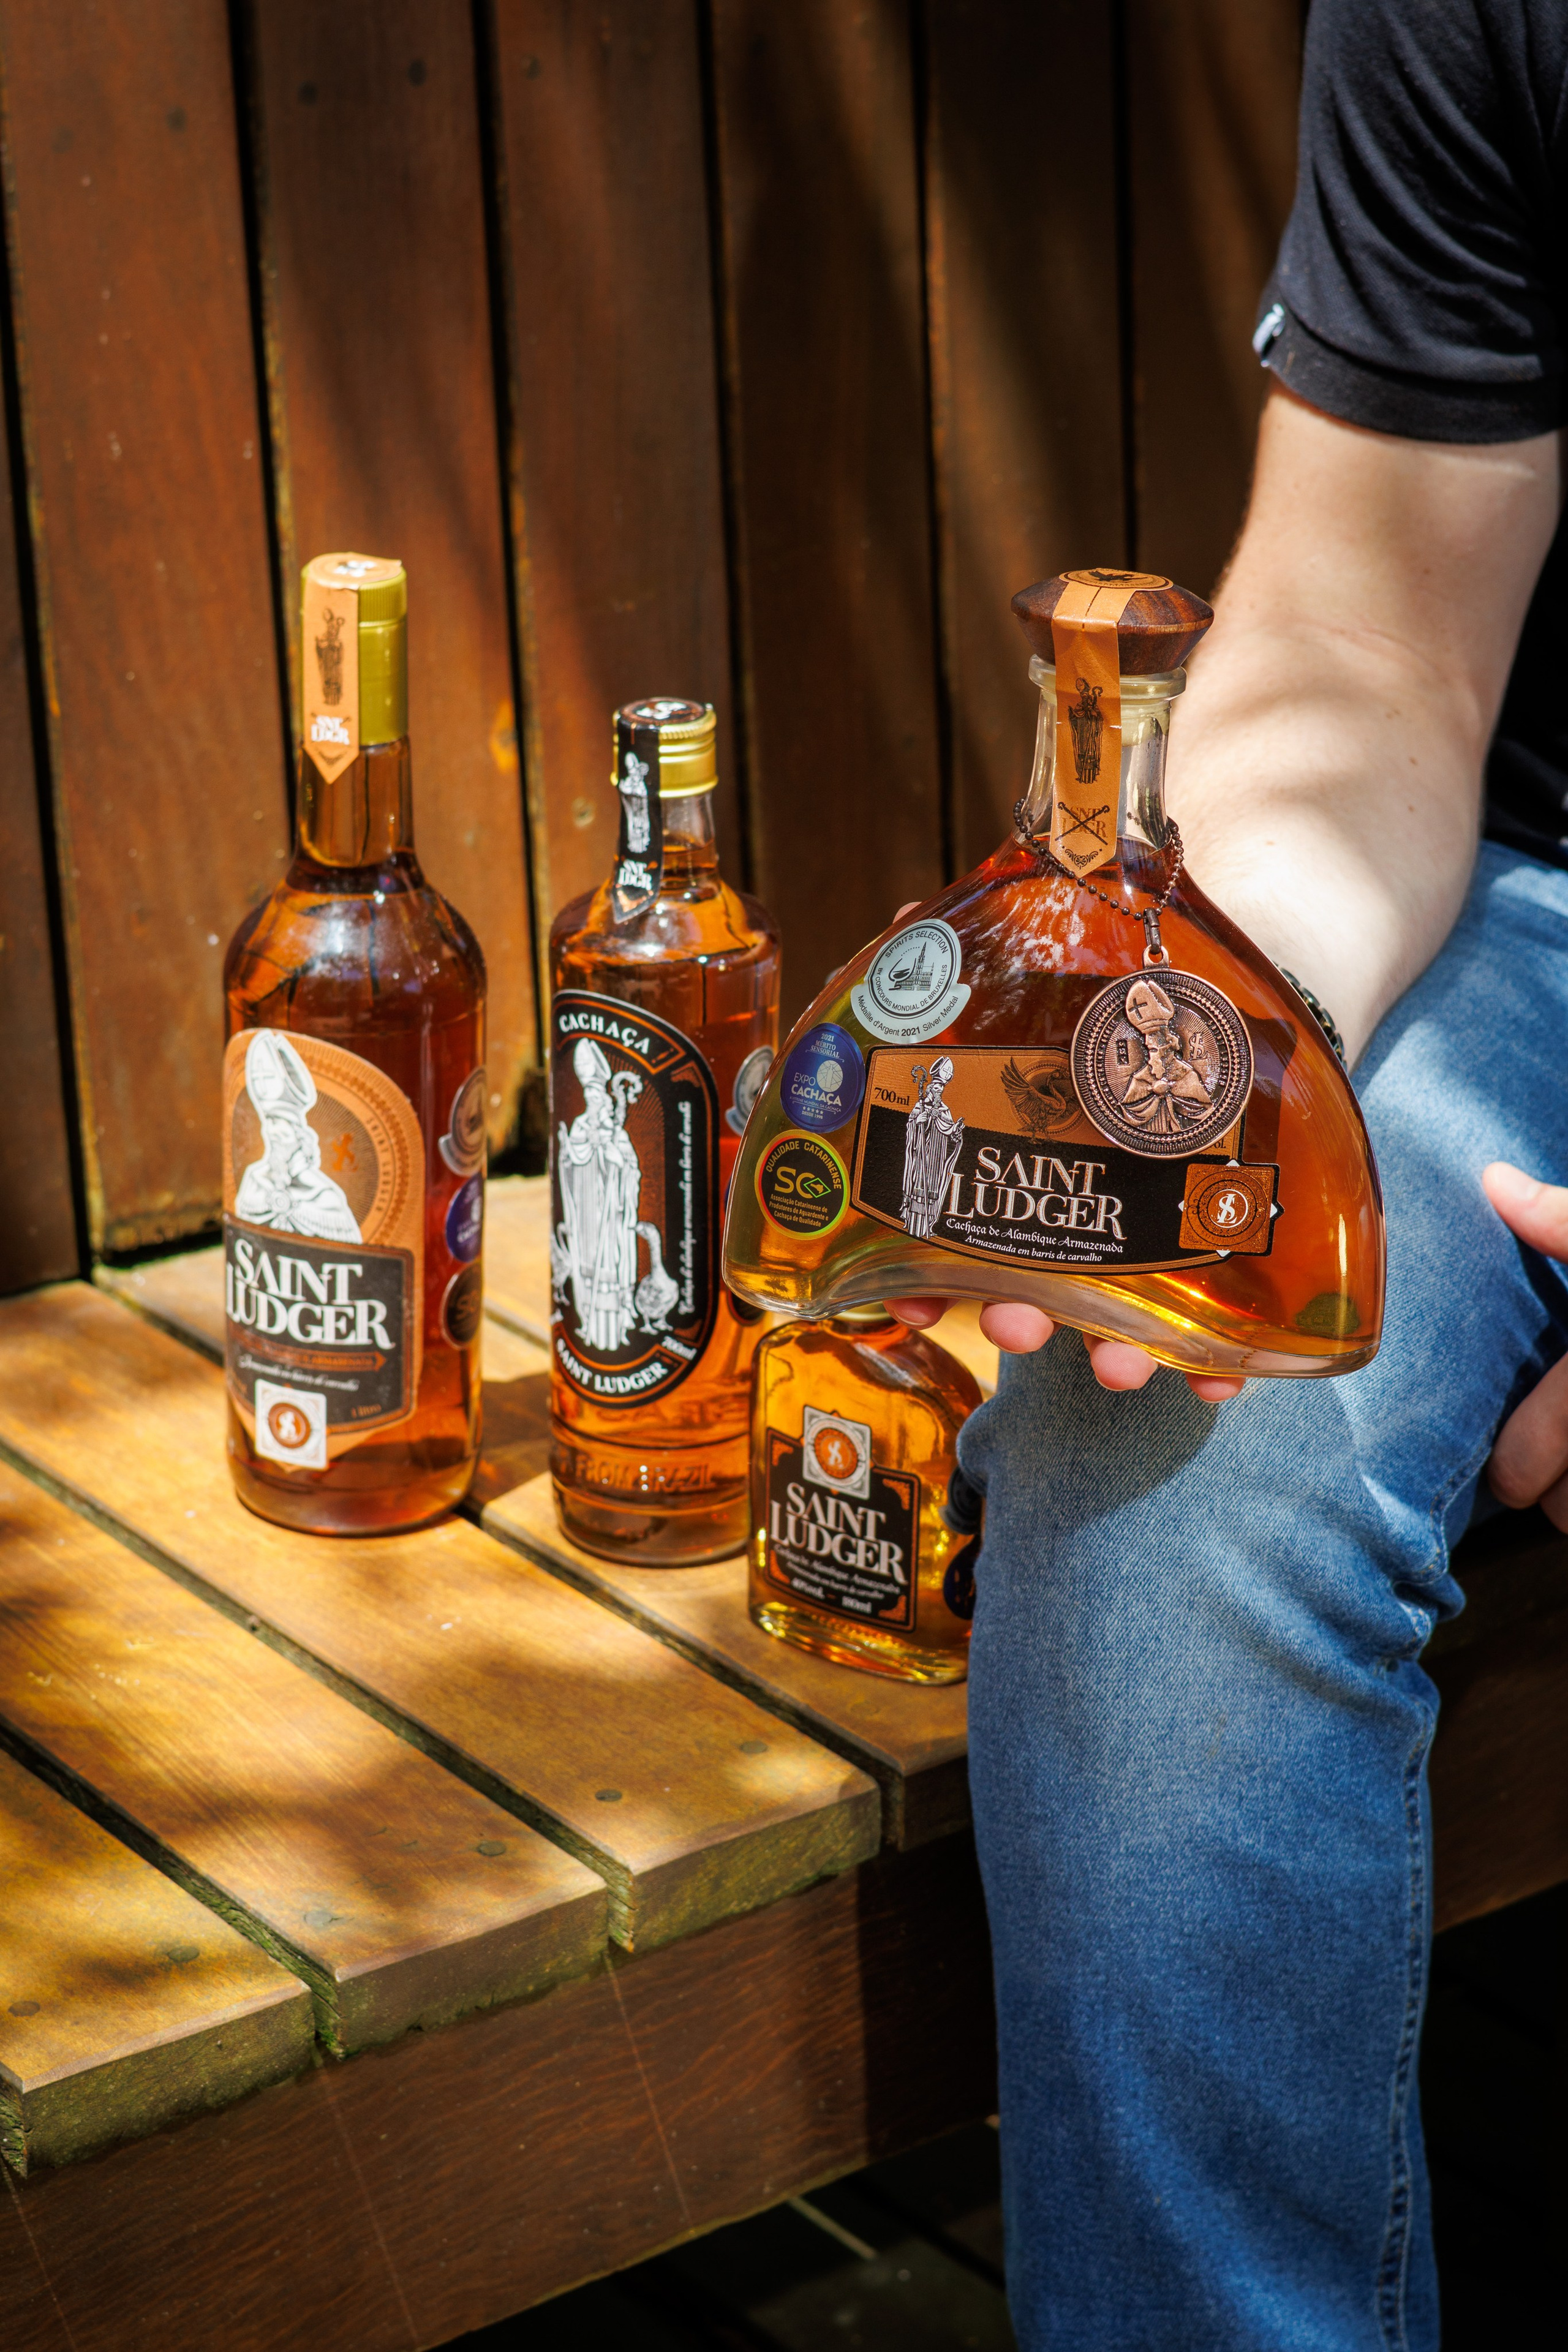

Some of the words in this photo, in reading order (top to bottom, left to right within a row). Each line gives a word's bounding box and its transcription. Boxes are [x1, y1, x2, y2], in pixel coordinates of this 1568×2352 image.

[886, 933, 913, 958] SPIRITS
[915, 930, 949, 954] SELECTION
[877, 967, 883, 976] BY
[929, 964, 948, 1000] BRUXELLES
[875, 976, 892, 1007] CONCOURS
[920, 998, 929, 1007] DE
[858, 995, 873, 1022] Médaille
[873, 1020, 900, 1036] d'Argent
[901, 1026, 921, 1036] 2021
[923, 1016, 941, 1031] Silver
[940, 995, 959, 1018] Medal
[892, 1003, 920, 1011] MONDIAL
[559, 1012, 650, 1054] CACHAÇA
[815, 1039, 836, 1051] MÉRITO
[821, 1033, 834, 1042] 2021
[810, 1045, 840, 1058] SENSORIAL
[794, 1072, 816, 1087] EXPO
[791, 1084, 842, 1107] CACHAÇA
[875, 1087, 910, 1106] 700ml
[766, 1141, 799, 1172] QUALIDADE
[804, 1142, 842, 1189] CATARINENSE
[973, 1147, 1106, 1197] SAINT
[769, 1201, 793, 1212] Produtores
[799, 1209, 825, 1220] Aguardente
[771, 1194, 794, 1205] Associação
[794, 1200, 821, 1211] Catarinense
[943, 1172, 1128, 1241] LUDGER
[774, 1210, 792, 1221] Cachaça
[799, 1216, 821, 1227] Qualidade
[946, 1218, 987, 1235] Cachaça
[989, 1226, 1000, 1236] de
[1001, 1228, 1057, 1246] Alambique
[1058, 1236, 1123, 1253] Armazenada
[965, 1235, 1016, 1253] Armazenada
[1031, 1248, 1055, 1259] barris
[1057, 1251, 1066, 1260] de
[1068, 1253, 1102, 1262] carvalho
[235, 1238, 363, 1306] SAINT
[226, 1261, 396, 1350] LUDGER
[557, 1338, 593, 1385] SAINT
[594, 1361, 668, 1394] LUDGER
[786, 1482, 886, 1542] SAINT
[771, 1499, 908, 1585] LUDGER
